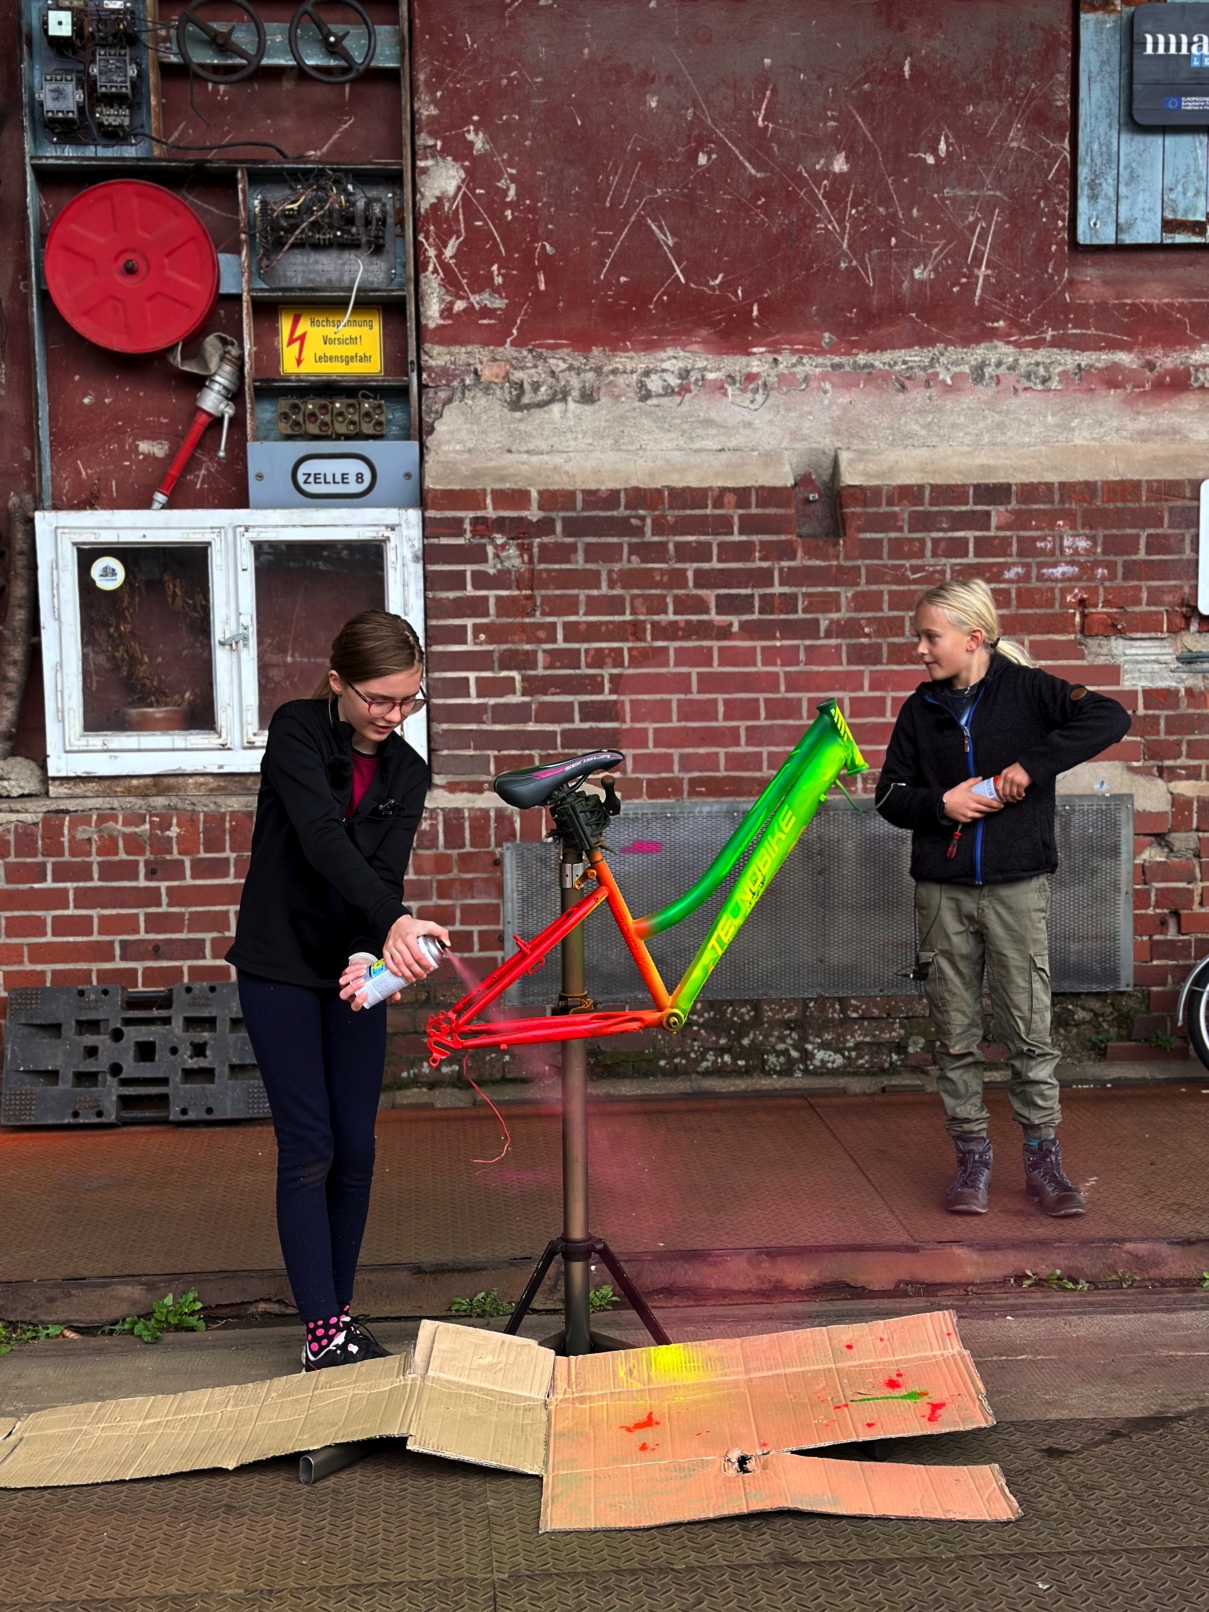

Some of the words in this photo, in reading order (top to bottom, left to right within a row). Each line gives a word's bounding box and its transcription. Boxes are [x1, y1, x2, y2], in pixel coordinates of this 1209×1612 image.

[322, 335, 362, 345] Vorsicht!
[314, 352, 372, 366] Lebensgefahr
[302, 472, 350, 485] ZELLE
[355, 472, 364, 485] 8
